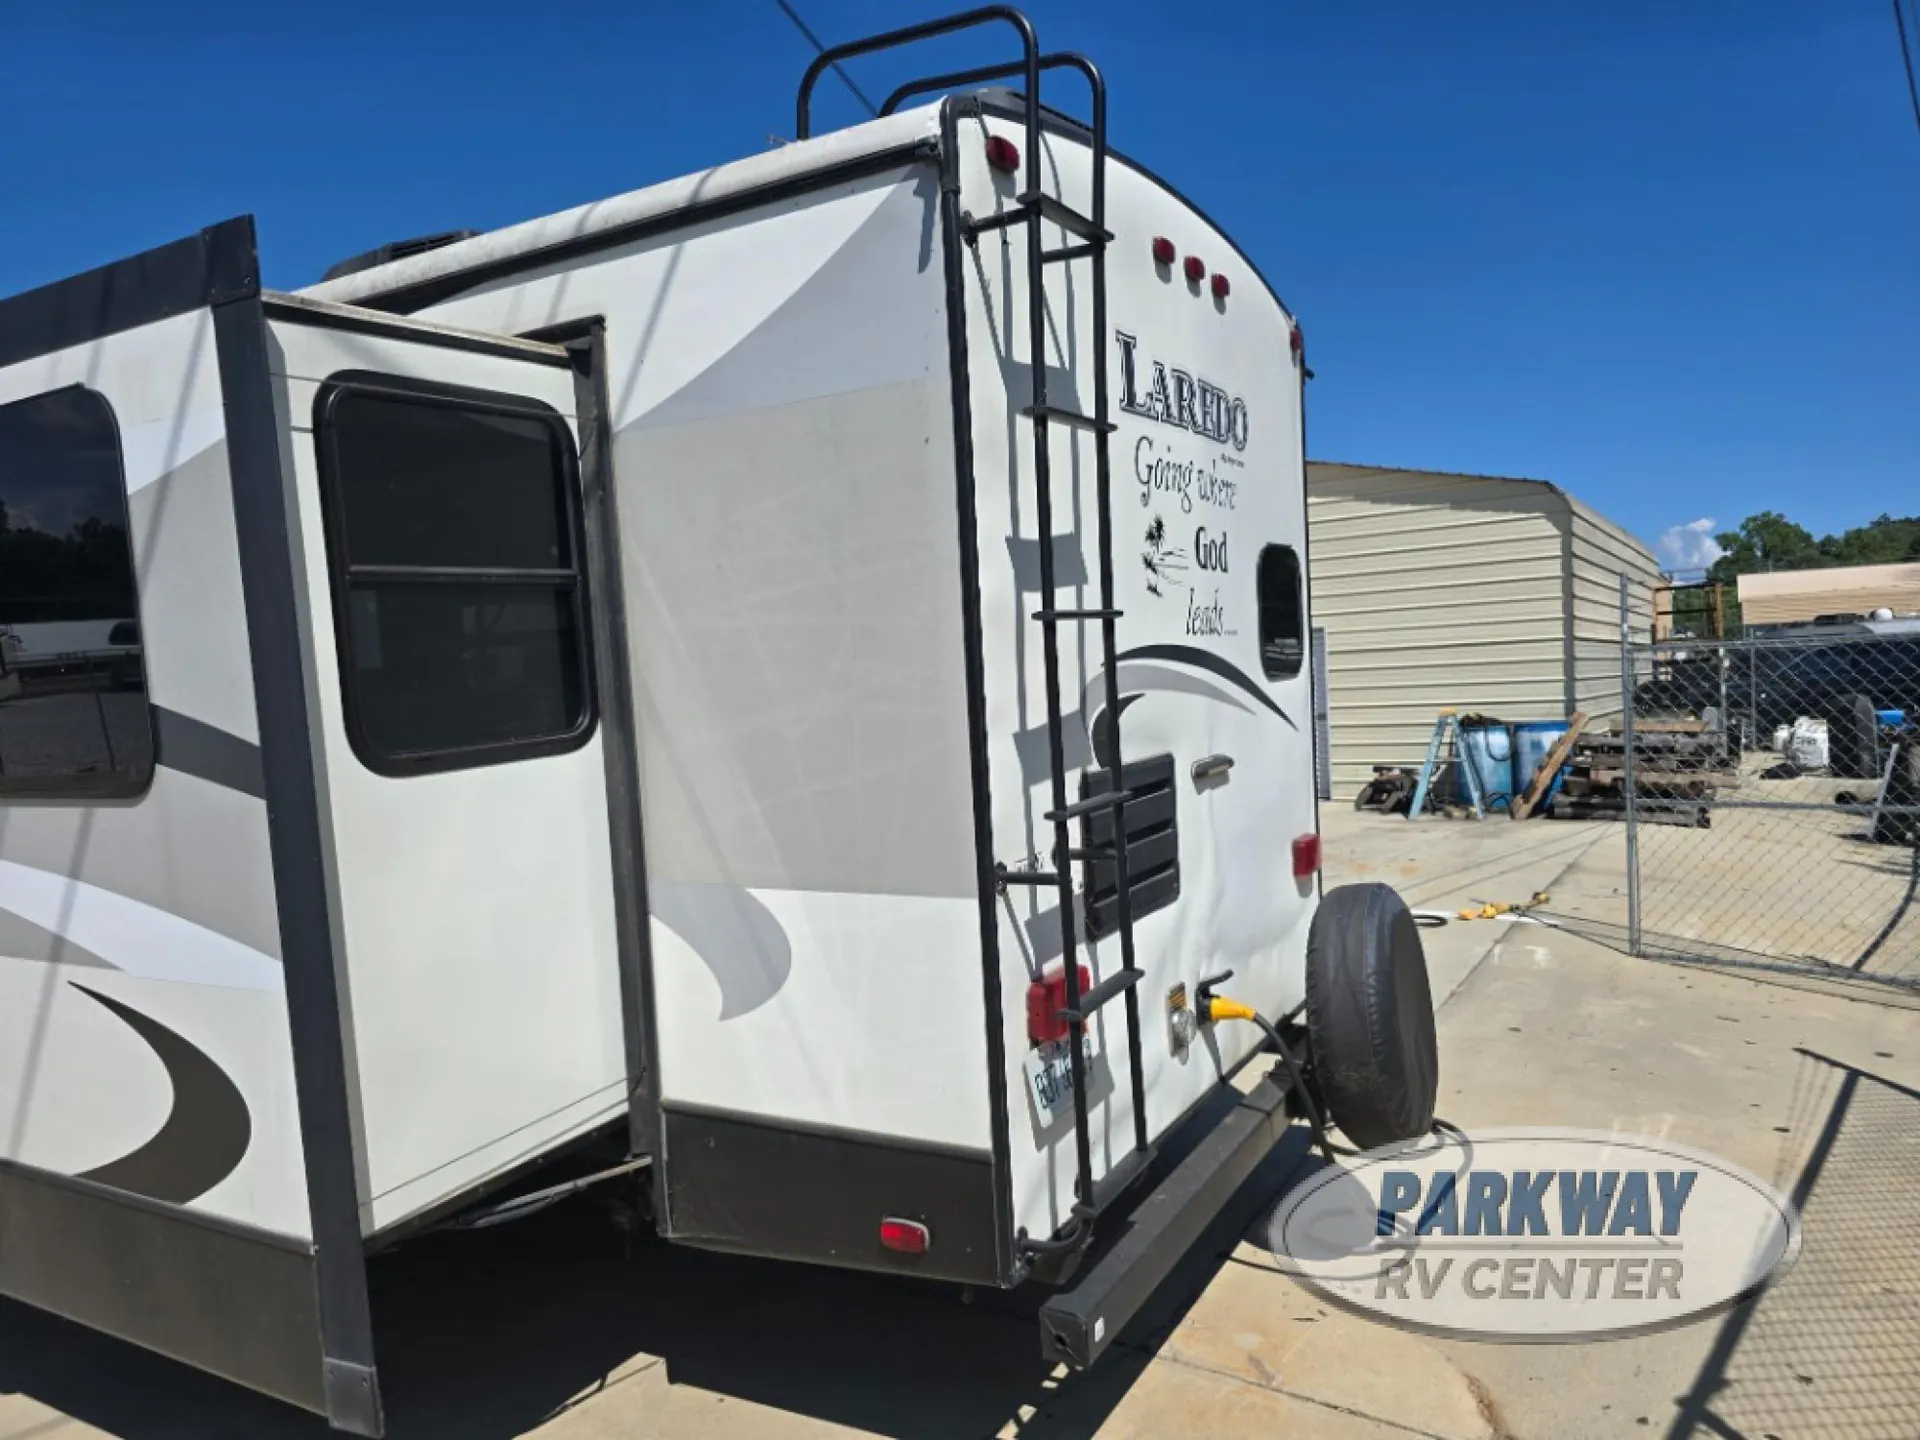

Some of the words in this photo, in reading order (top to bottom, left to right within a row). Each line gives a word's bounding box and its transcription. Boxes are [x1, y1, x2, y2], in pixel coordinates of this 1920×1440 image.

[1115, 330, 1248, 451] LAREDO
[1134, 436, 1193, 514] Going
[1197, 459, 1238, 510] where
[1194, 526, 1229, 573] God
